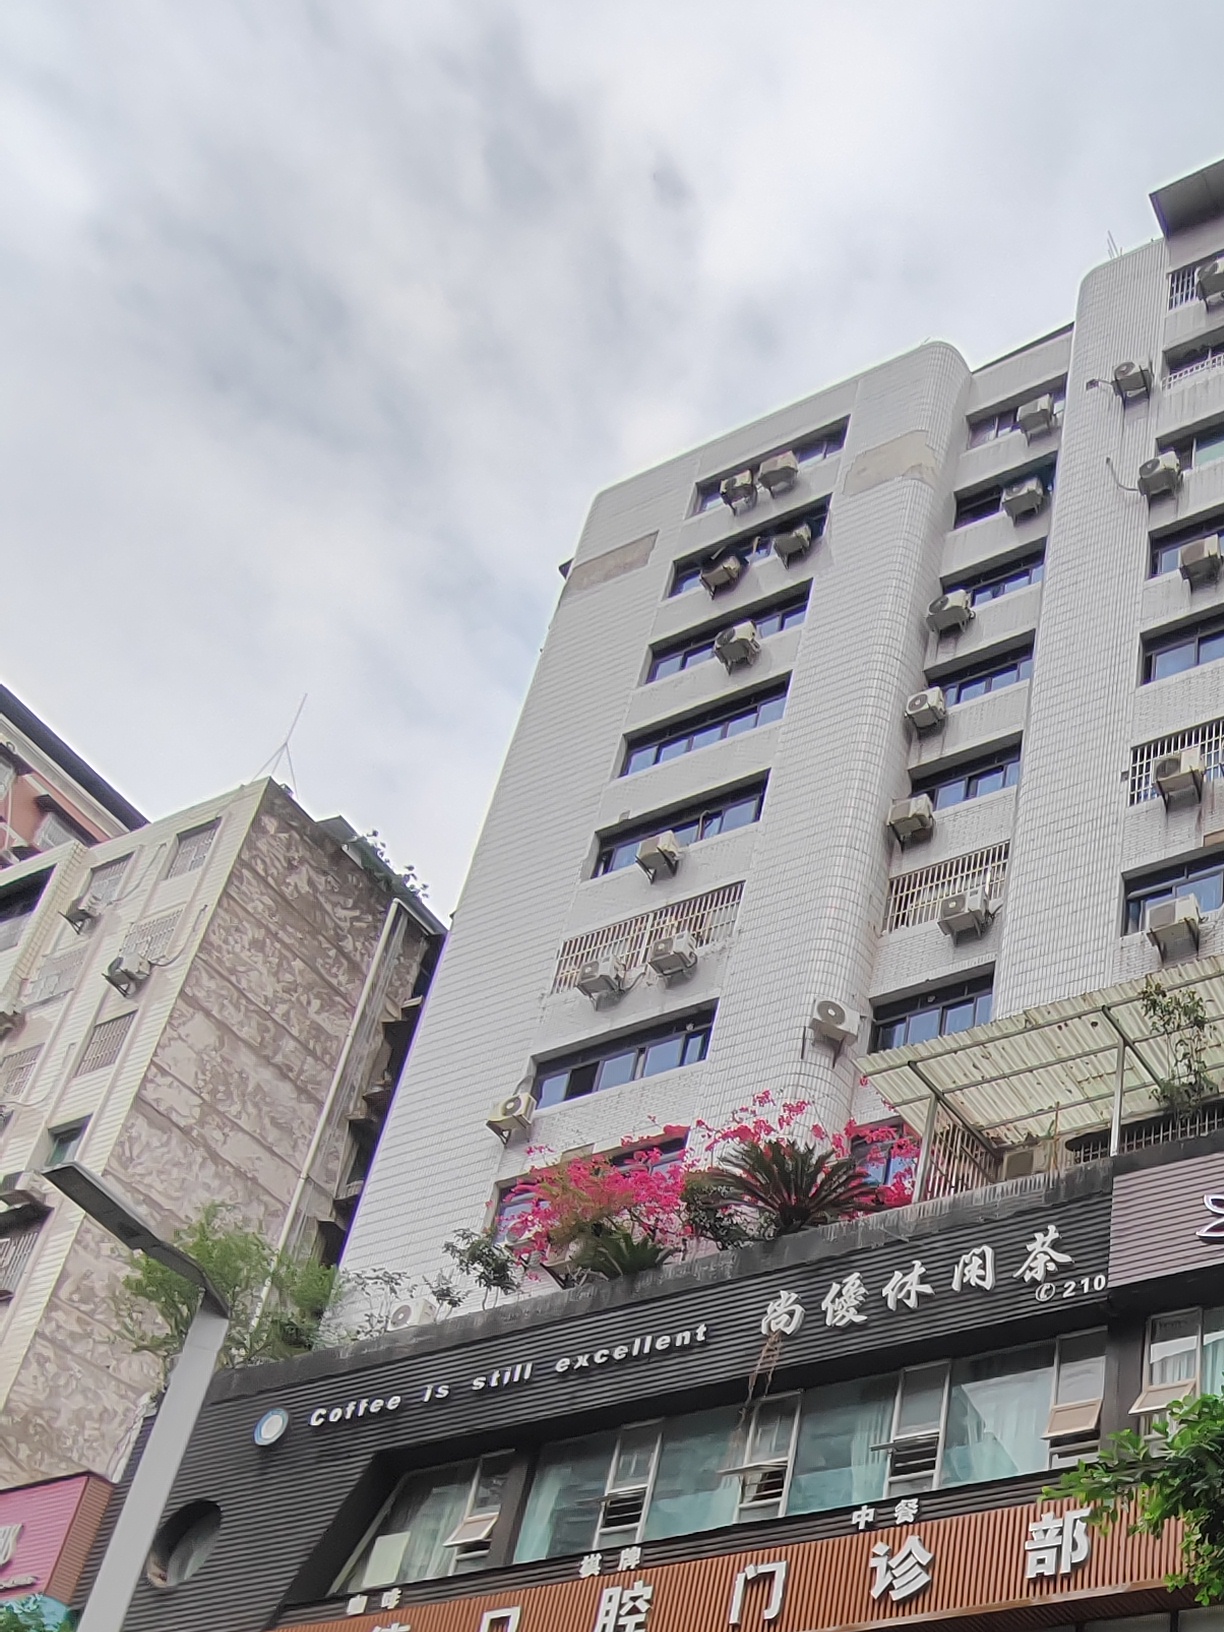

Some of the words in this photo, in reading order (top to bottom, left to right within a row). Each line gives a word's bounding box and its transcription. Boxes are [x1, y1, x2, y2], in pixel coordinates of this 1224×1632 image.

[309, 1391, 402, 1428] Coffee
[422, 1383, 451, 1404] is
[470, 1361, 534, 1393] still
[553, 1324, 709, 1375] excellent
[851, 1498, 919, 1530] 中餐
